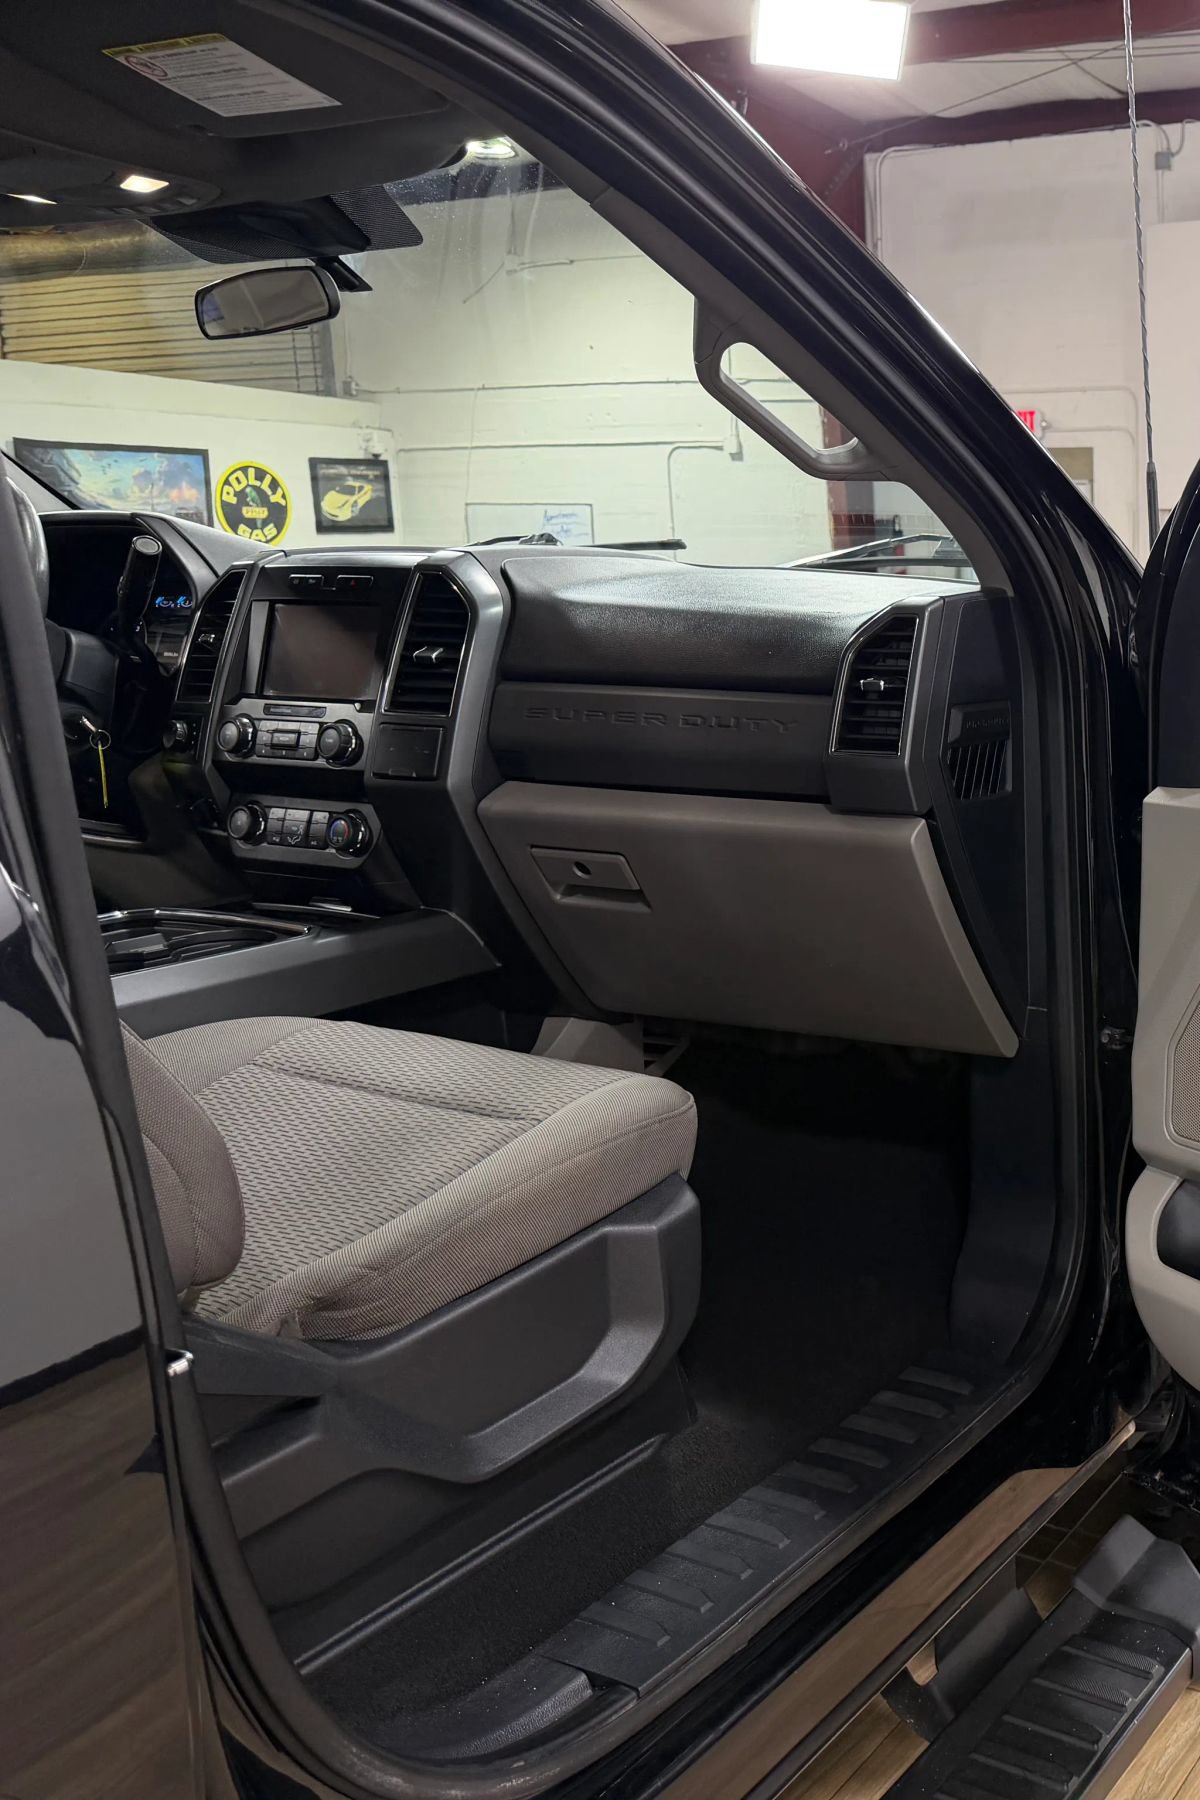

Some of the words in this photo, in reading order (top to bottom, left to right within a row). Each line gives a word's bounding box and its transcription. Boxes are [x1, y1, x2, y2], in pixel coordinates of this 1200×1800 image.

[222, 467, 286, 507] POLLY
[237, 523, 278, 542] GAS
[523, 706, 668, 728] SUPER
[679, 712, 799, 734] DUTY
